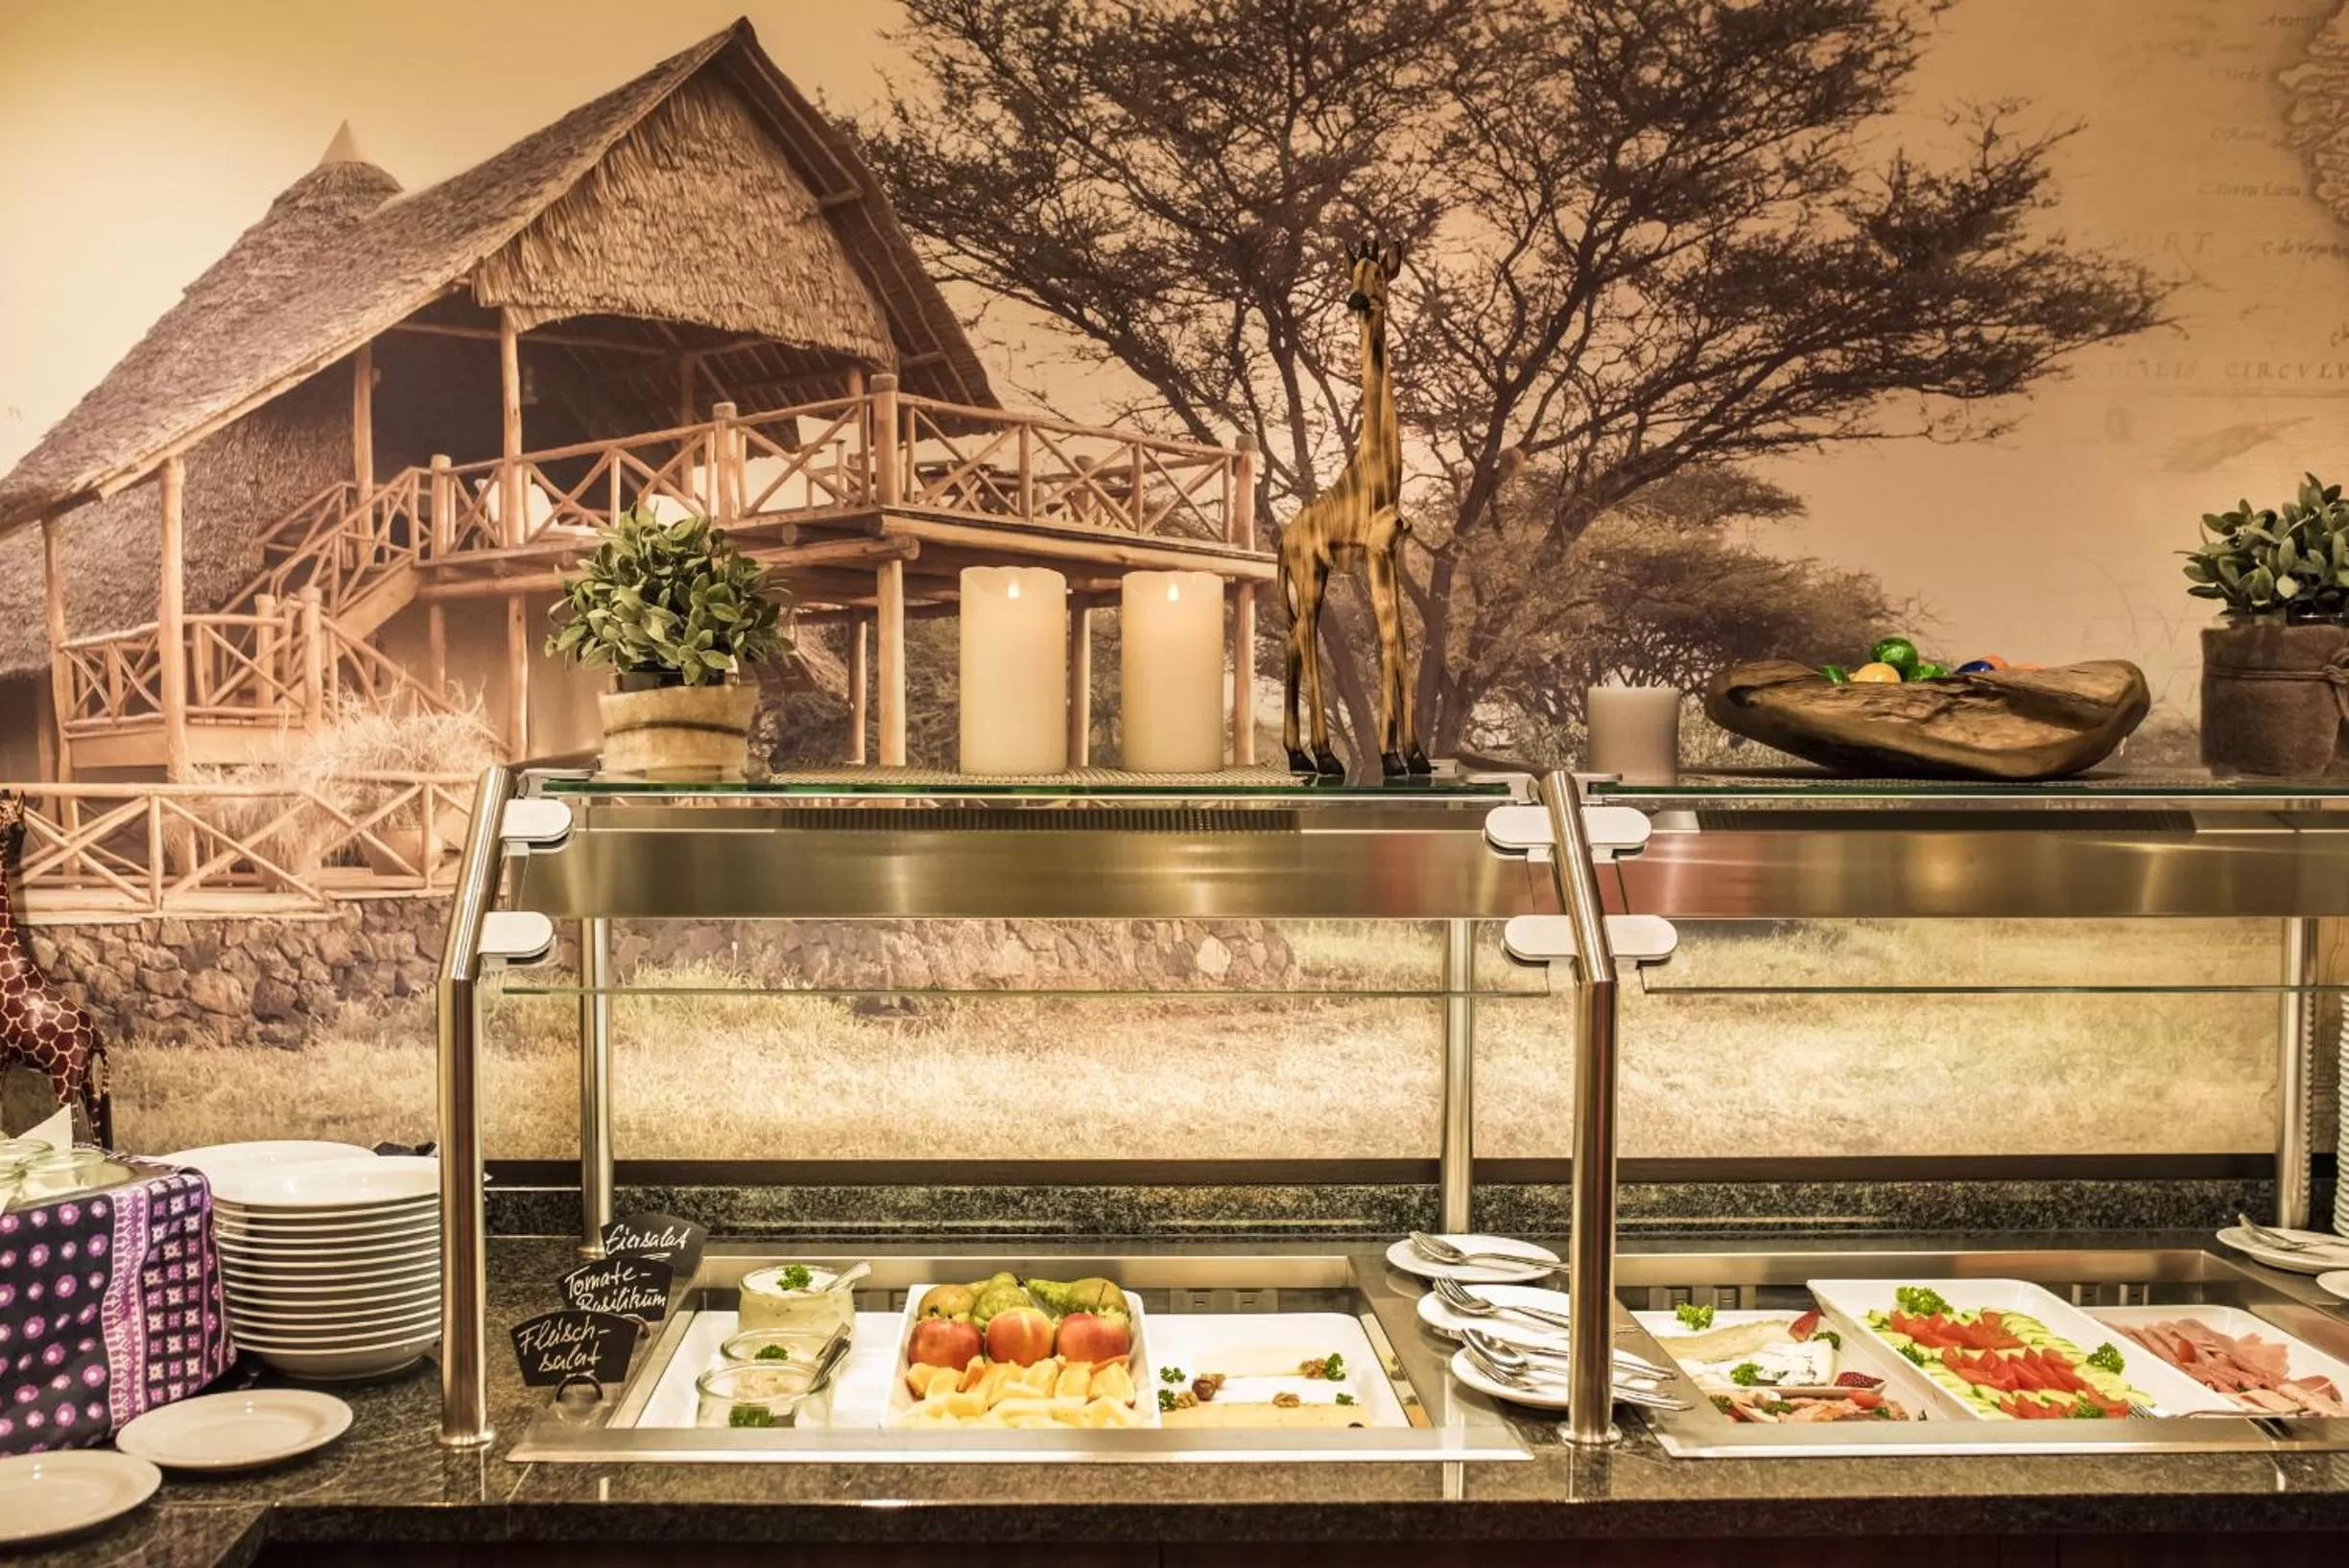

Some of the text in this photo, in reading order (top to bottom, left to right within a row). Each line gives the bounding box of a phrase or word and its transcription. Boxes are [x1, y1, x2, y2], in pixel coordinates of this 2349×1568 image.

[564, 1261, 652, 1299] Tomate-
[517, 1315, 611, 1356] Fleisch-
[538, 1341, 603, 1372] salat
